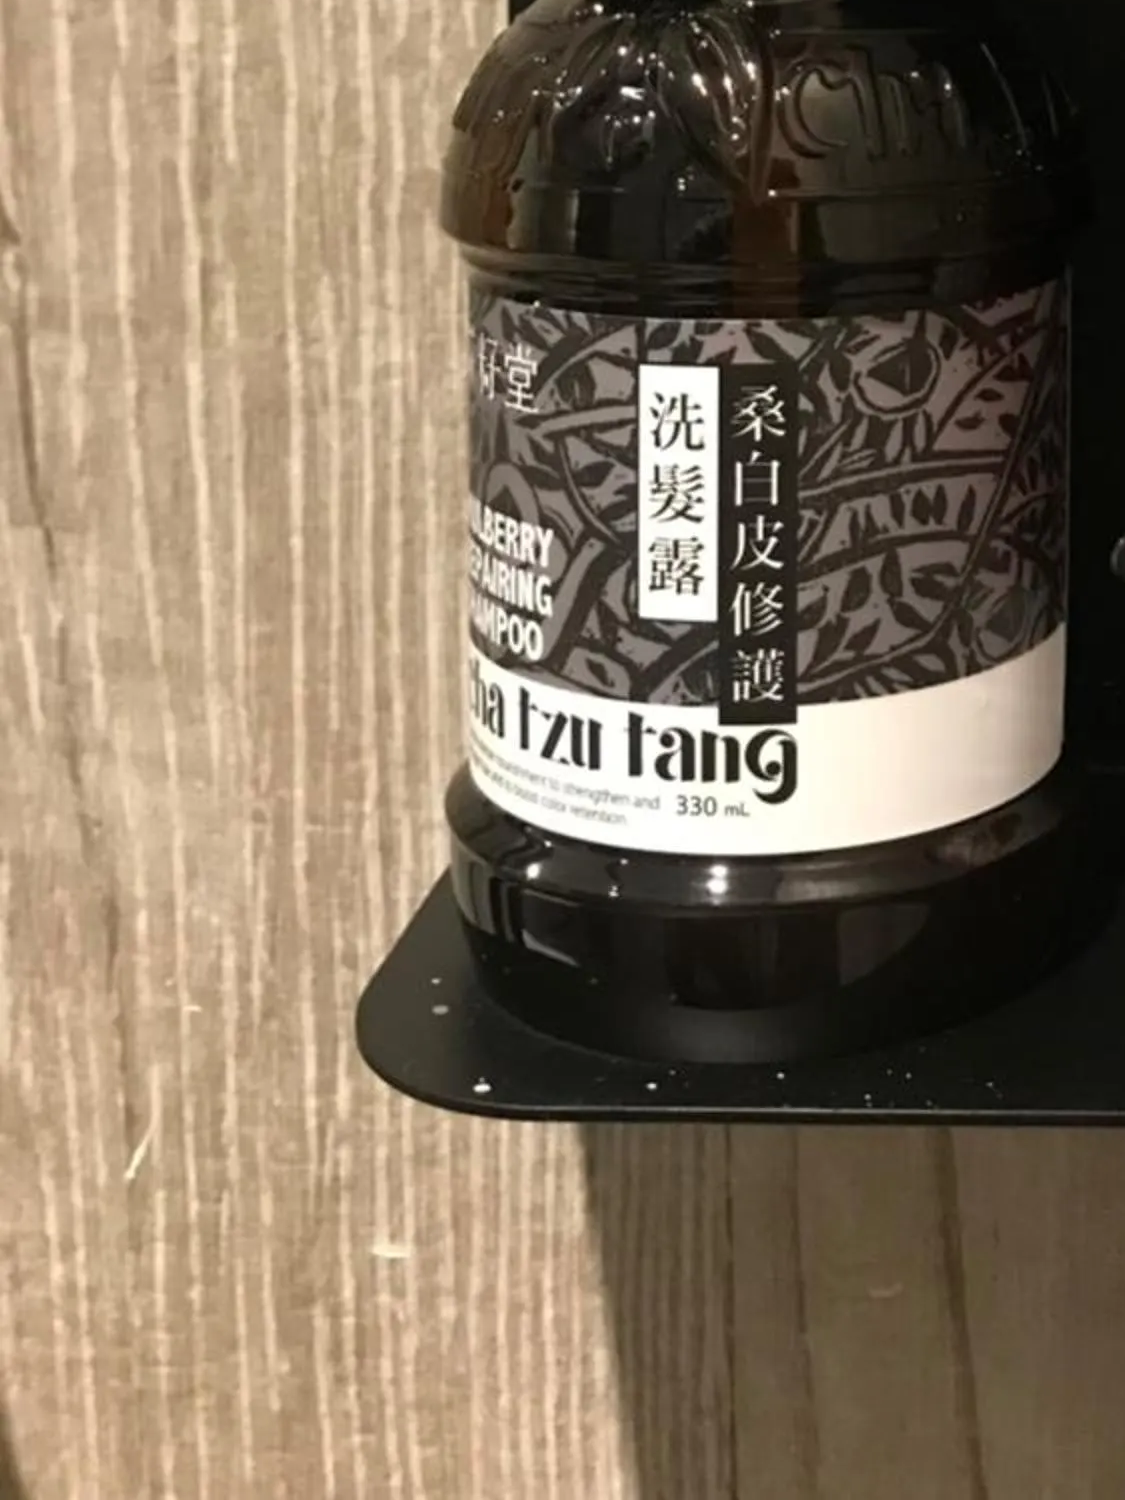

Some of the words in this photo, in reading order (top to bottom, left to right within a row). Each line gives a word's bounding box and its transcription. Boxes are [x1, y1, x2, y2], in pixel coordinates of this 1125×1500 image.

[478, 332, 540, 413] 籽堂
[647, 390, 706, 597] 洗髮露
[470, 543, 554, 618] PAIRING
[730, 384, 787, 703] 桑白皮修護
[469, 656, 505, 740] ha
[518, 686, 603, 772] tzu
[624, 711, 798, 805] tang
[633, 794, 661, 811] and
[676, 795, 718, 817] 330
[724, 802, 750, 817] mL
